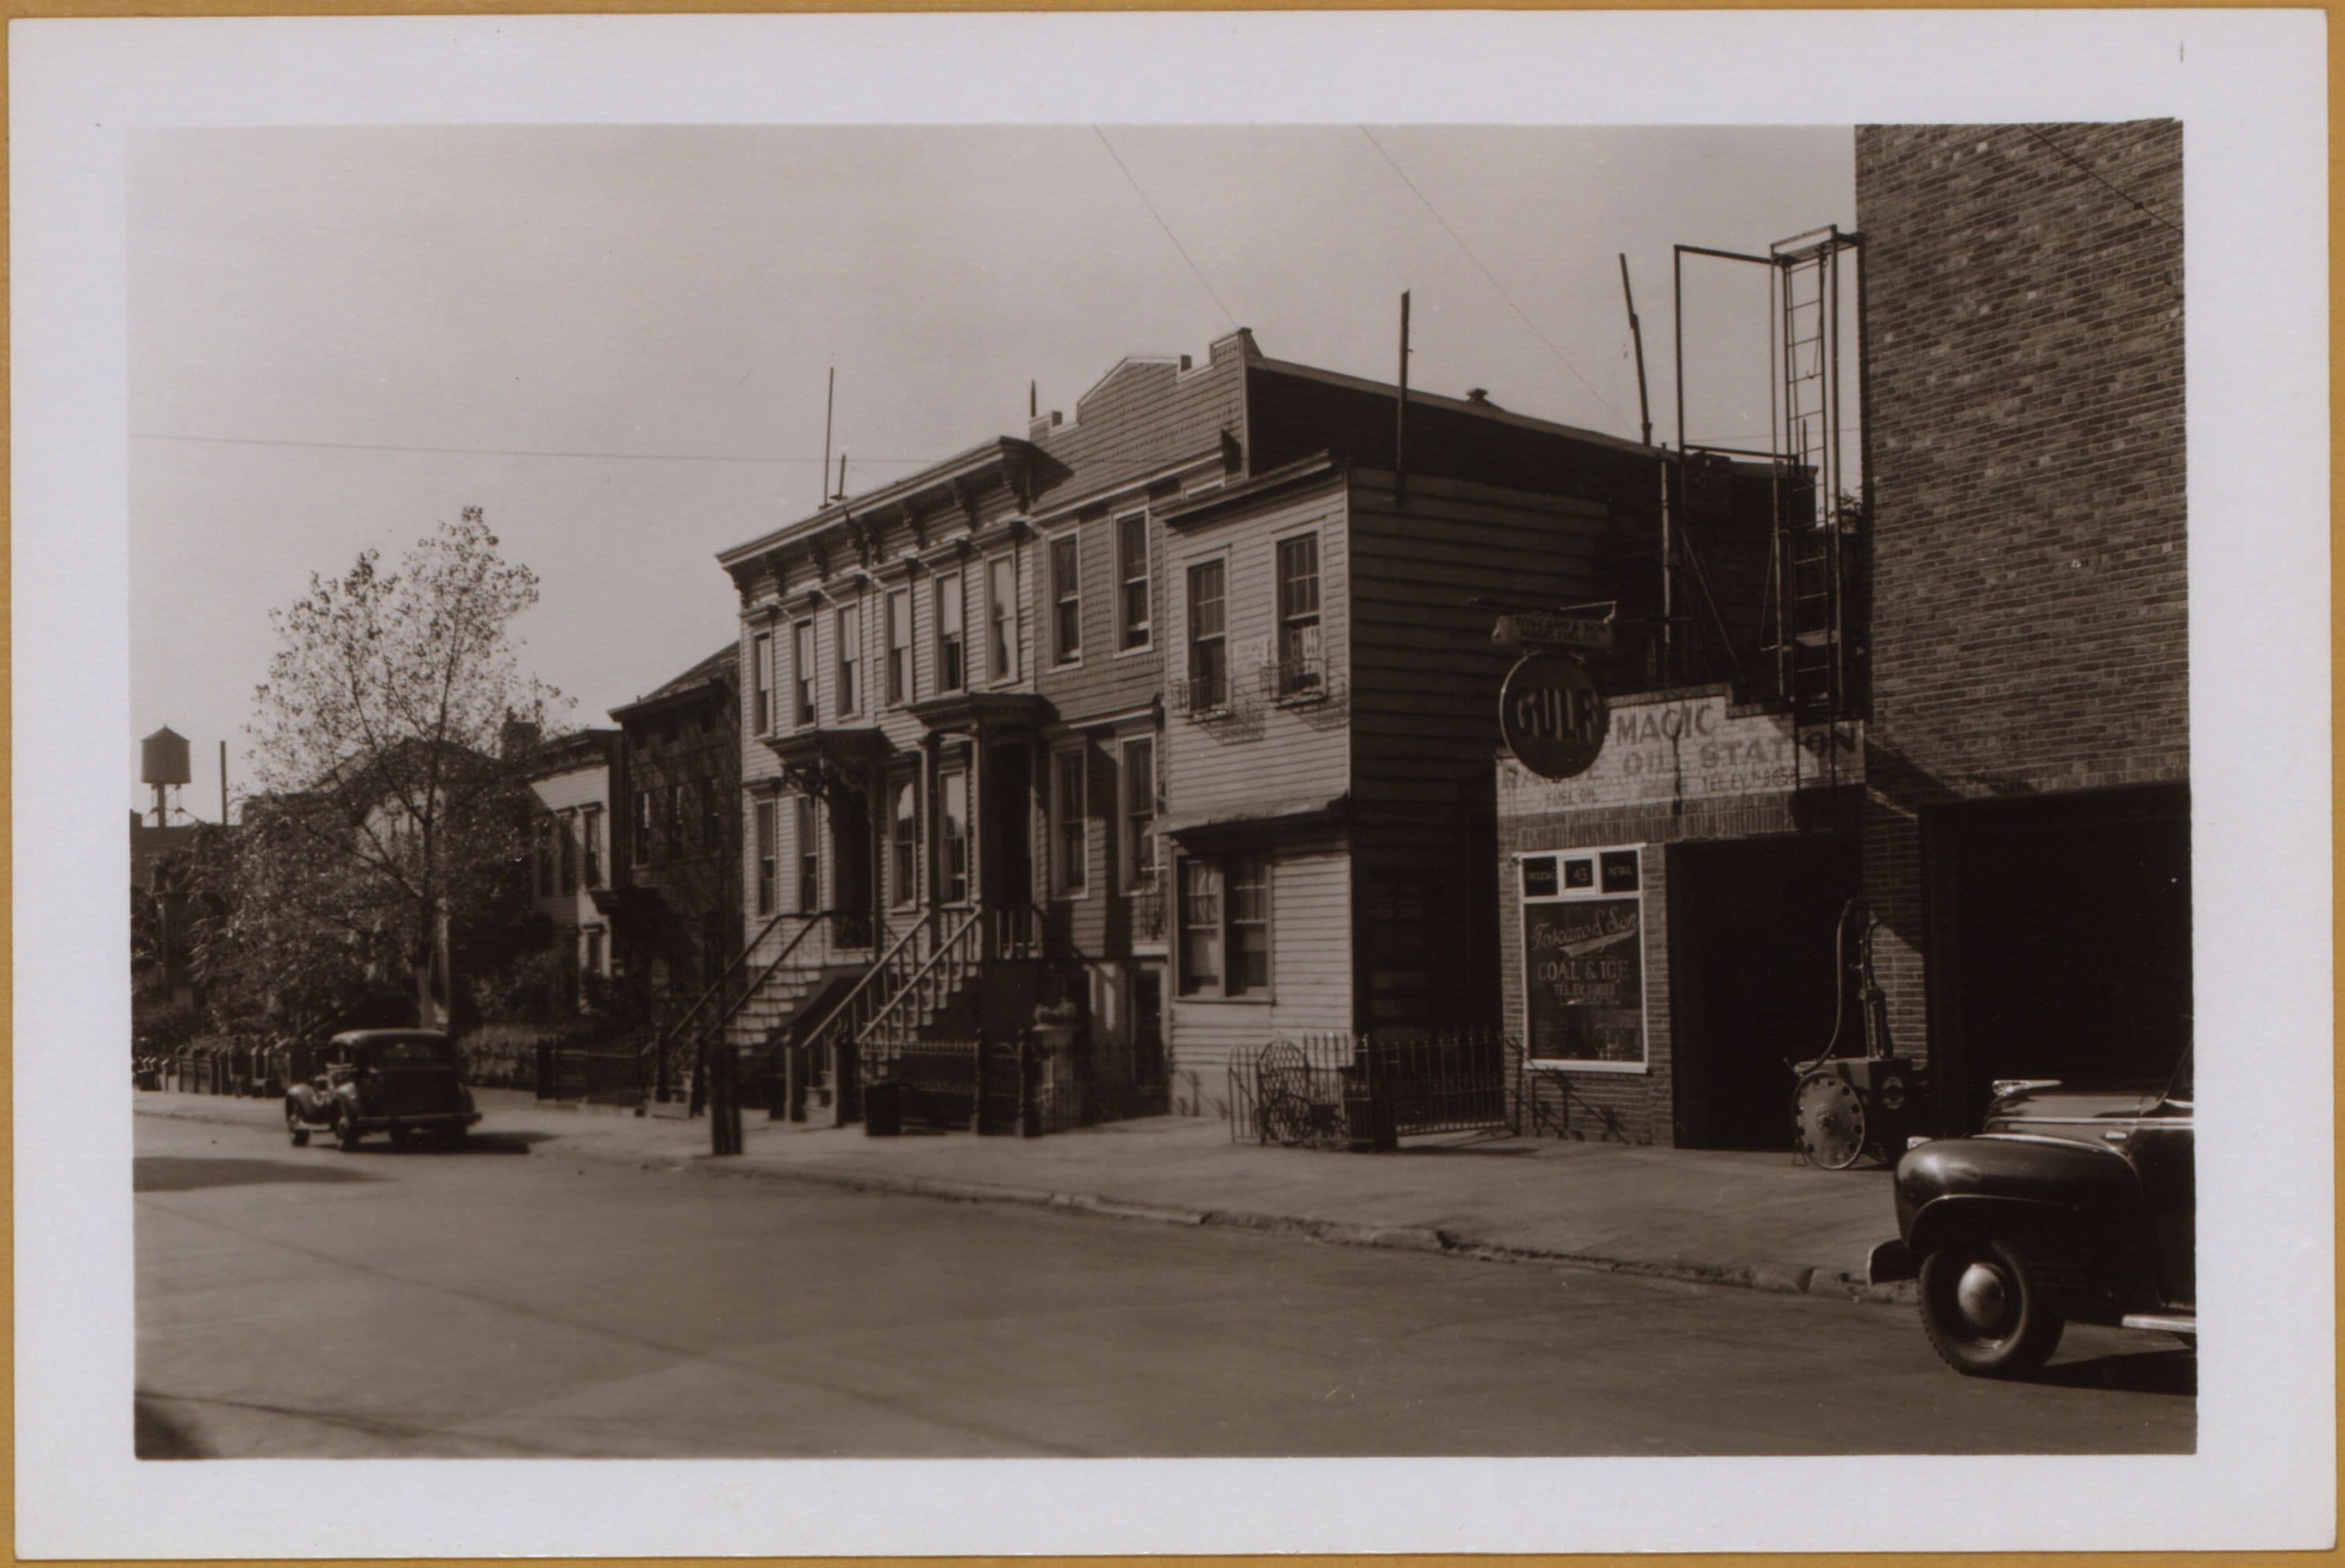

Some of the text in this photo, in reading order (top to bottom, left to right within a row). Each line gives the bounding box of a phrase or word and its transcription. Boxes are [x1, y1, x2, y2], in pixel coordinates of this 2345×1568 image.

[1617, 705, 1714, 746] MAGIC
[1699, 727, 1857, 769] STATON
[1572, 866, 1589, 883] 45
[1537, 961, 1581, 980] COAL
[1600, 959, 1631, 980] ICE
